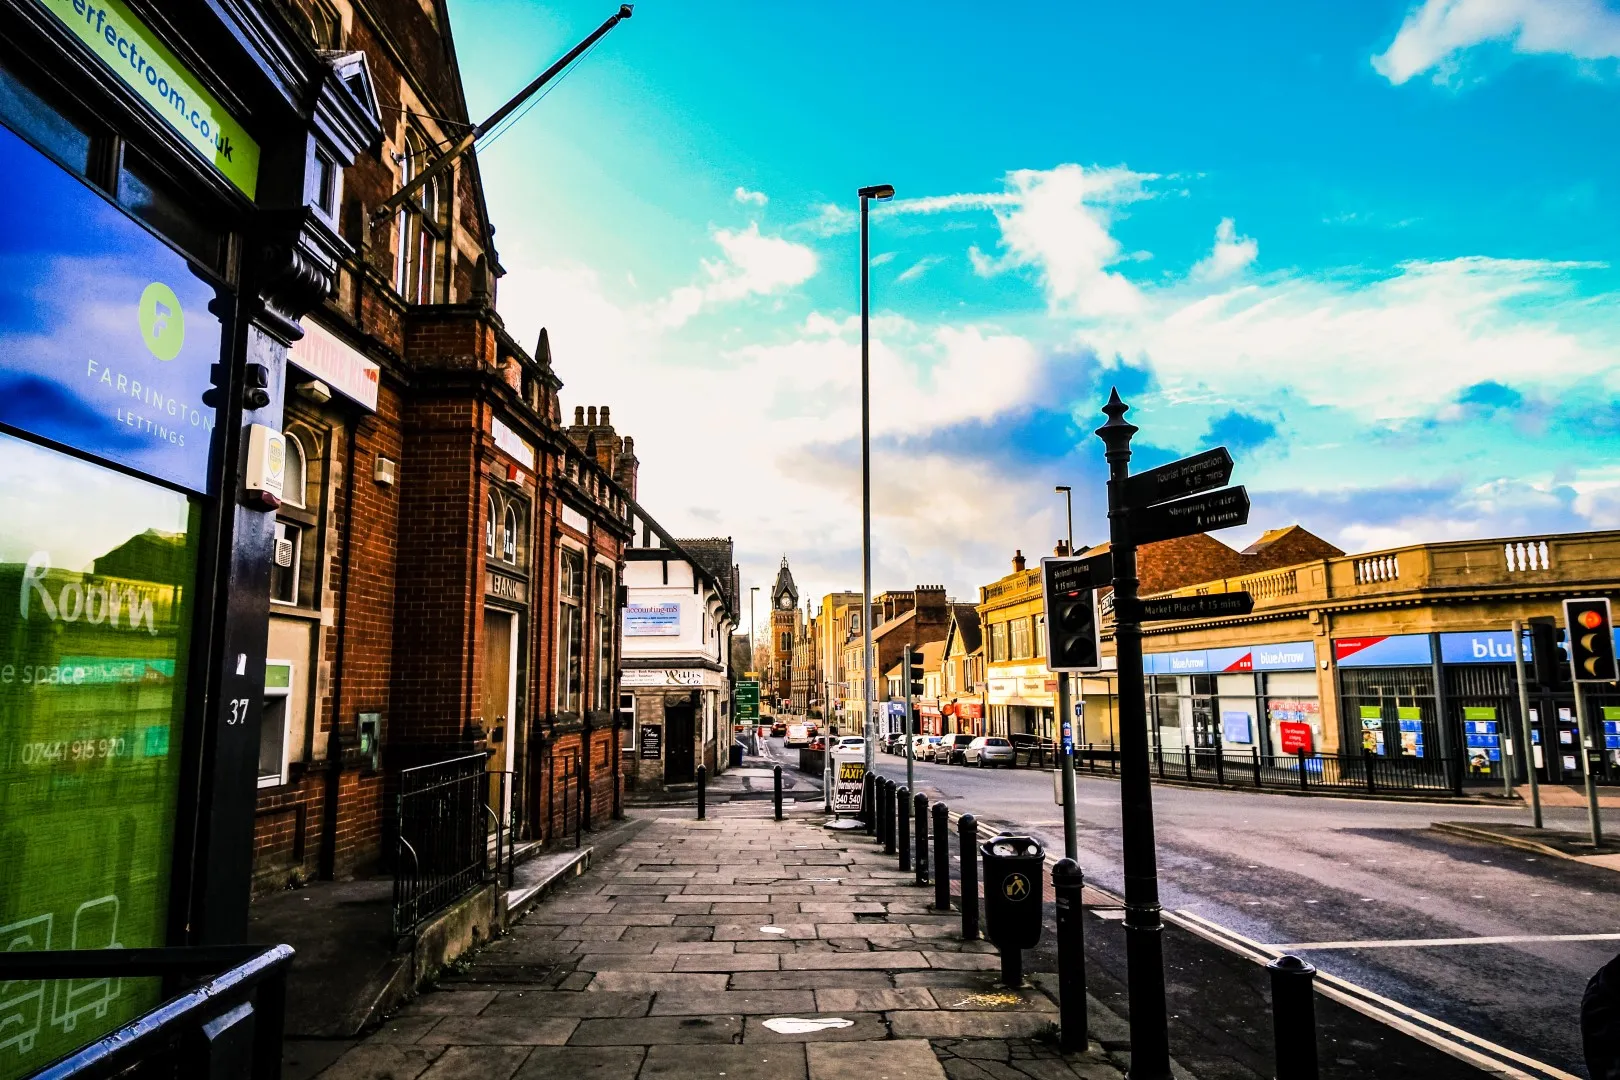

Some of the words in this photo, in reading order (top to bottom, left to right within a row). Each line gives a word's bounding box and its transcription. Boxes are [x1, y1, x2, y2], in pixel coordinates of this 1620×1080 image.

[58, 0, 234, 163] erfectroom.co.uk
[87, 359, 215, 433] FARRINGTON
[117, 407, 185, 447] LETTINGS
[1156, 468, 1179, 483] Tourist
[1181, 456, 1222, 476] Information
[1206, 470, 1223, 480] mins
[1168, 502, 1206, 516] Shopping
[1208, 495, 1236, 508] Centre
[1218, 511, 1239, 522] mins
[1073, 564, 1090, 574] Marina
[492, 574, 517, 599] BANK
[1060, 582, 1066, 591] 15
[1066, 580, 1076, 588] mins
[20, 551, 159, 637] Room
[1144, 605, 1172, 615] Market
[1174, 603, 1196, 612] Place
[1208, 600, 1217, 610] 15
[1220, 599, 1241, 609] mins
[1172, 657, 1204, 669] blueArrow
[1260, 651, 1304, 665] blueArrow
[23, 663, 86, 690] space
[664, 670, 701, 679] Willis
[227, 699, 249, 724] 37
[841, 769, 864, 779] TAXI?
[836, 794, 848, 804] 540
[849, 794, 861, 804] 540
